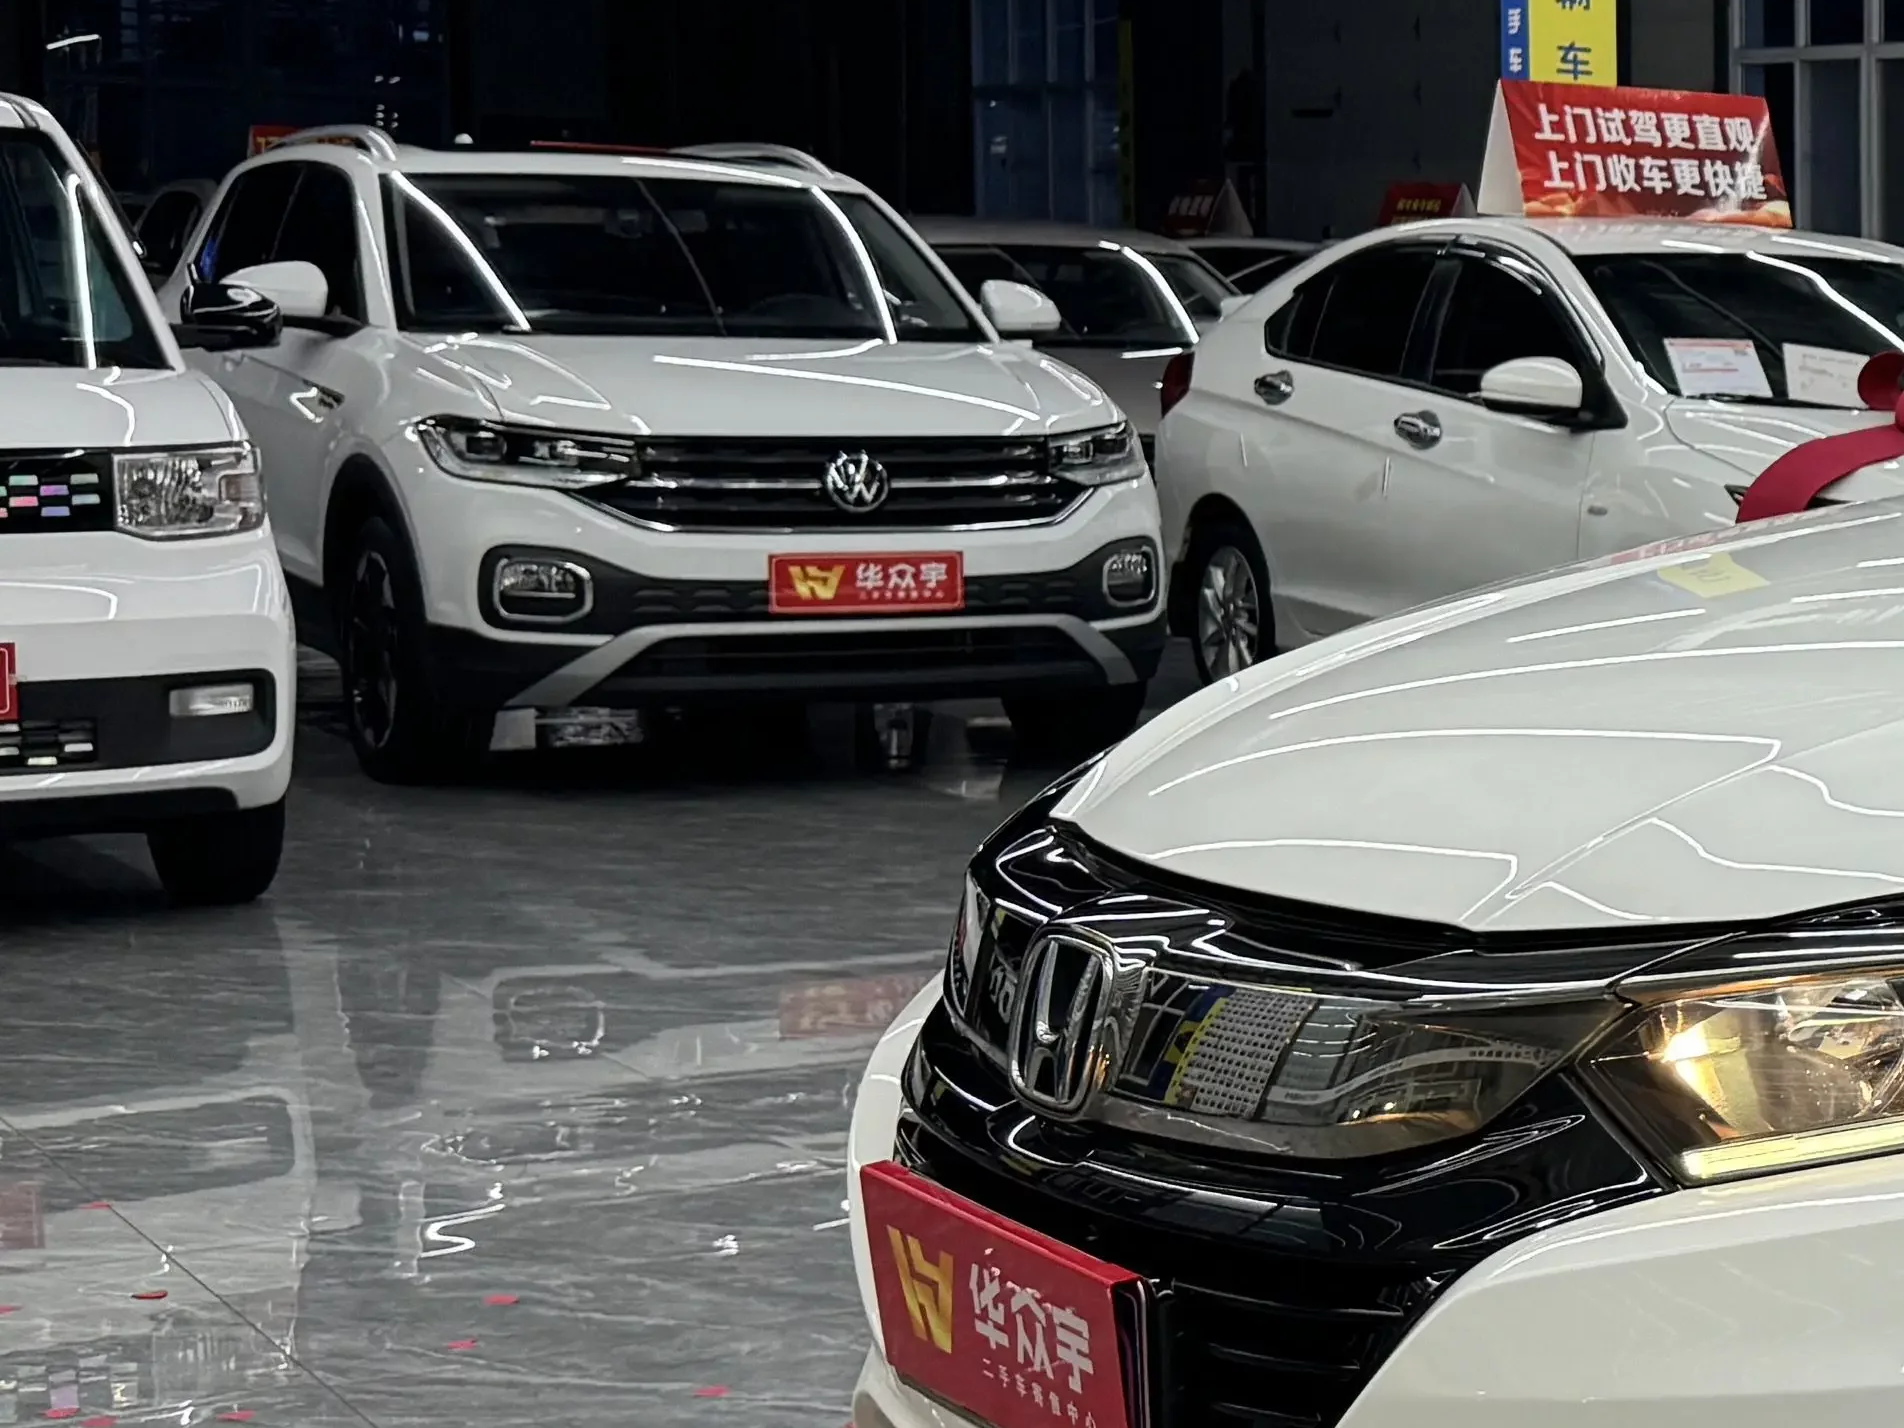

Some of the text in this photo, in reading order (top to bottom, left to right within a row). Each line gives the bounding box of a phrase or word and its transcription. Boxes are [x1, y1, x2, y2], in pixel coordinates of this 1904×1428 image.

[1534, 102, 1755, 152] 上门试驾更直观
[1544, 150, 1768, 200] 上门收车更快捷
[855, 562, 948, 590] 华众宇
[968, 1262, 1095, 1395] 华众宇
